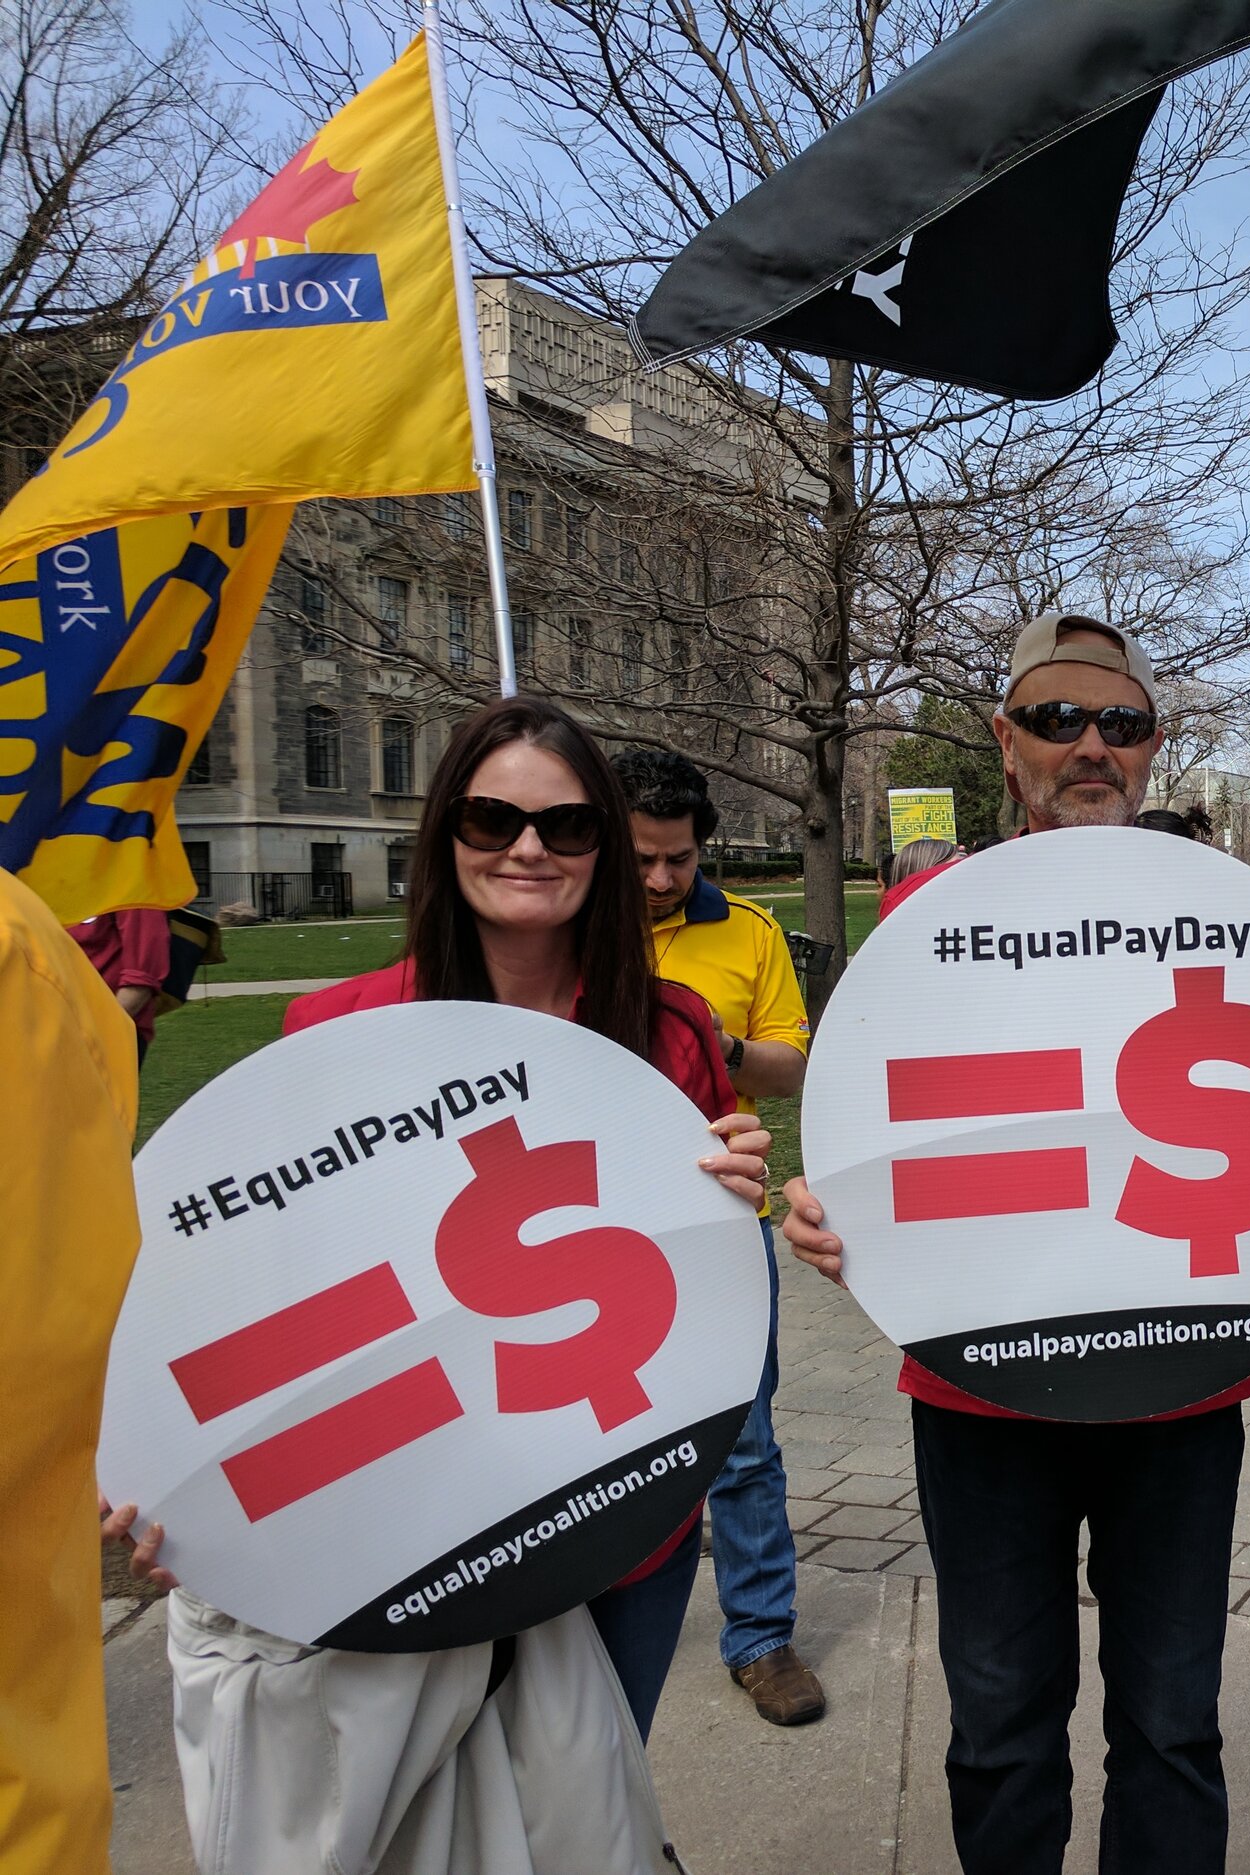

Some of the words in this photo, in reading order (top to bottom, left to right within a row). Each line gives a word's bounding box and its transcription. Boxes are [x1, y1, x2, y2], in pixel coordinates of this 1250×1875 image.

[53, 536, 111, 633] ork
[921, 796, 952, 804] WORKERS
[923, 810, 954, 821] FIGHT
[893, 823, 953, 833] RESISTANCE
[933, 916, 1250, 970] #EqualPayDay
[168, 1061, 530, 1237] #EqualPayDay
[386, 1440, 698, 1623] equalpaycoalition.org
